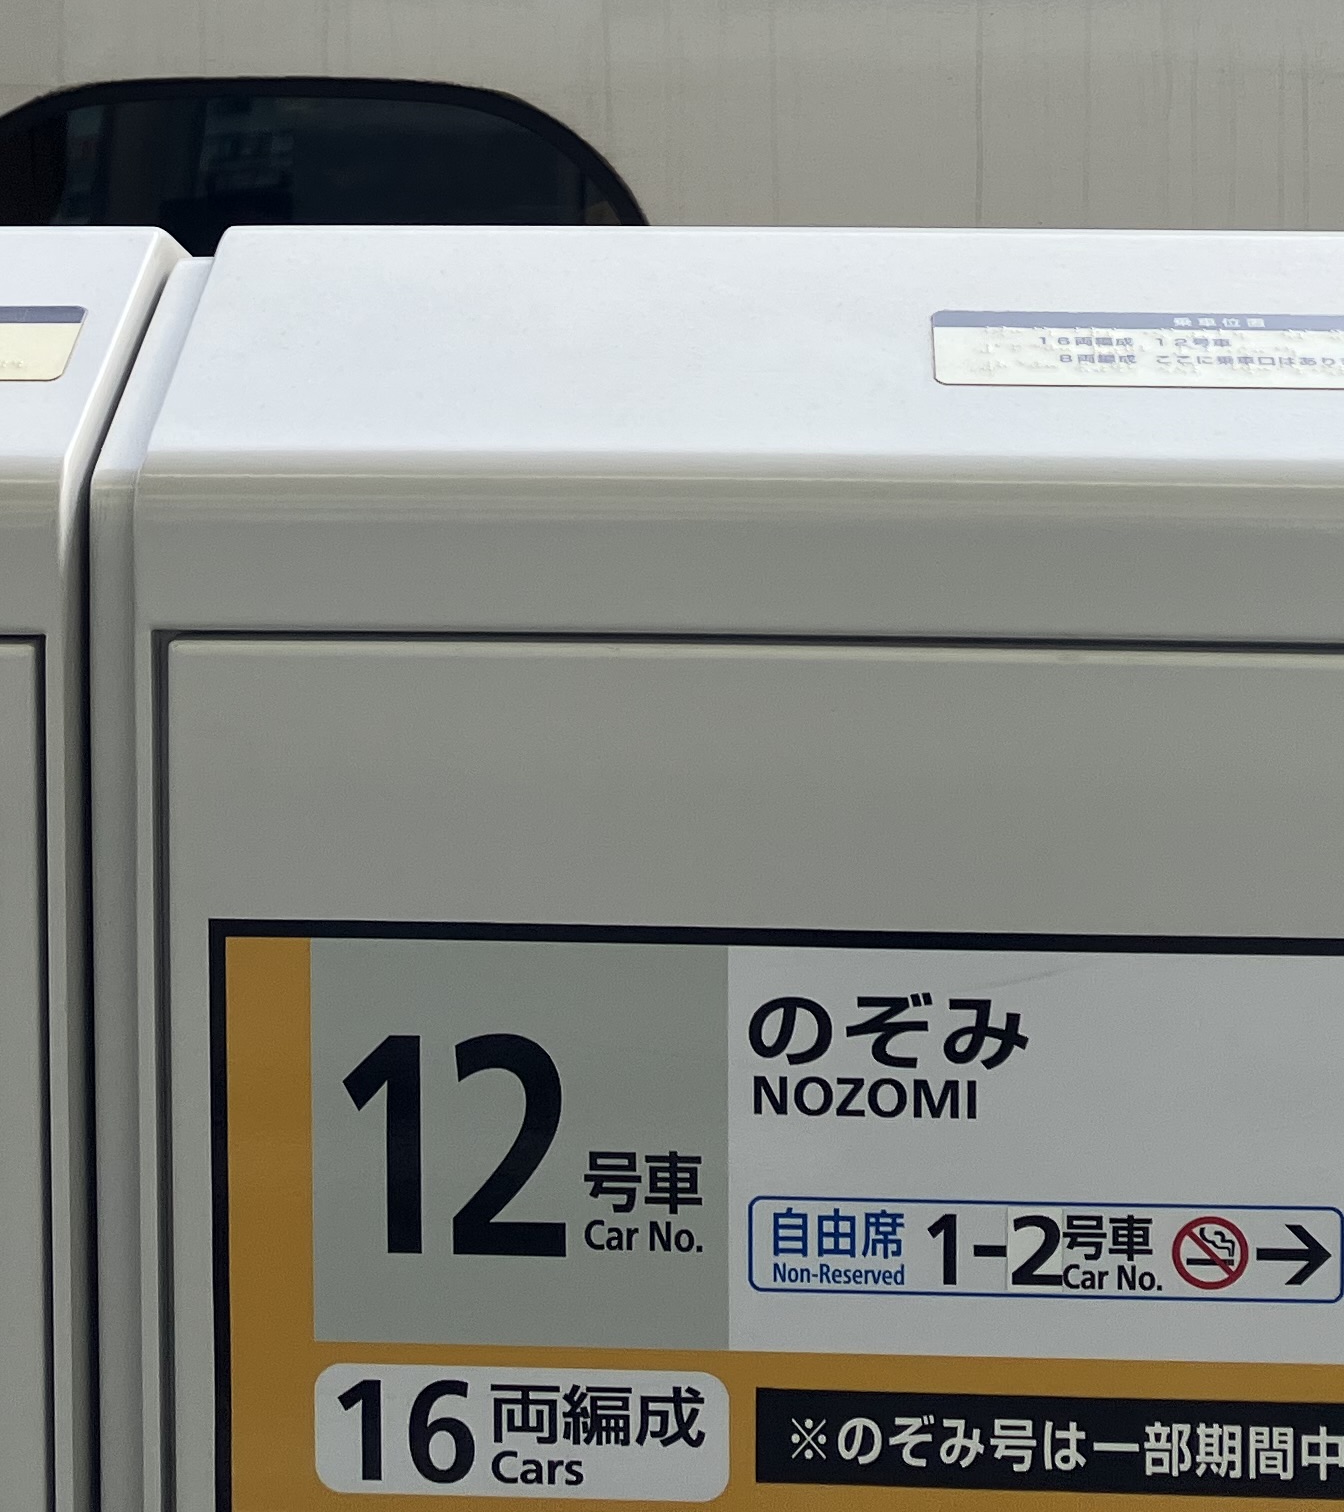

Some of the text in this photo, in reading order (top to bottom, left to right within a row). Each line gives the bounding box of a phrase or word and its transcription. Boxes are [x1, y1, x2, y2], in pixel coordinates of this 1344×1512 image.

[1173, 316, 1266, 329] 乗車位置
[749, 993, 1028, 1069] のぞみ
[754, 1076, 976, 1119] NOZOMI
[343, 1034, 702, 1257] 12 号車
[585, 1220, 702, 1252] Car No.
[774, 1209, 902, 1257] 自由席
[774, 1265, 903, 1284] Non-Reserved
[1062, 1264, 1163, 1291] Car No.
[338, 1380, 705, 1483] 16 両編成
[492, 1451, 583, 1485] Cars
